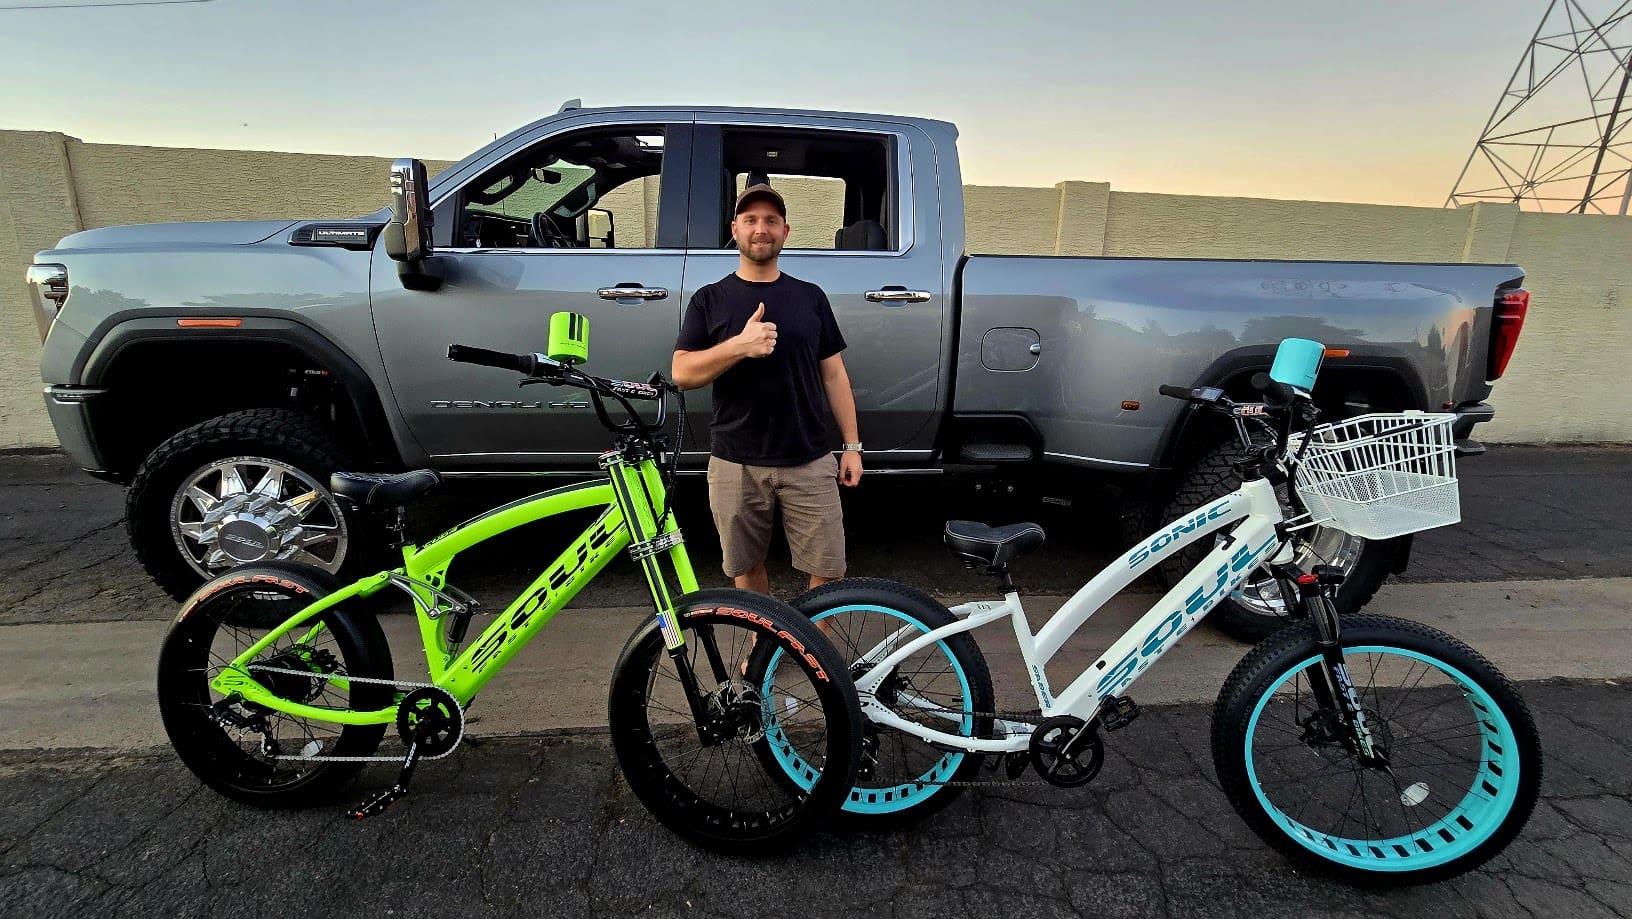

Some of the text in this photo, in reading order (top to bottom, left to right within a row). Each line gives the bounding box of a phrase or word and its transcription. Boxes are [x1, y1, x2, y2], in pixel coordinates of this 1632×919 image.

[430, 400, 541, 408] DENALI
[1128, 500, 1232, 570] SONIC
[471, 520, 626, 673] SOUL
[1203, 541, 1277, 612] BIKES
[716, 607, 829, 682] SOUL FAST
[1096, 534, 1277, 701] SOUL
[1336, 663, 1374, 759] SOUL
